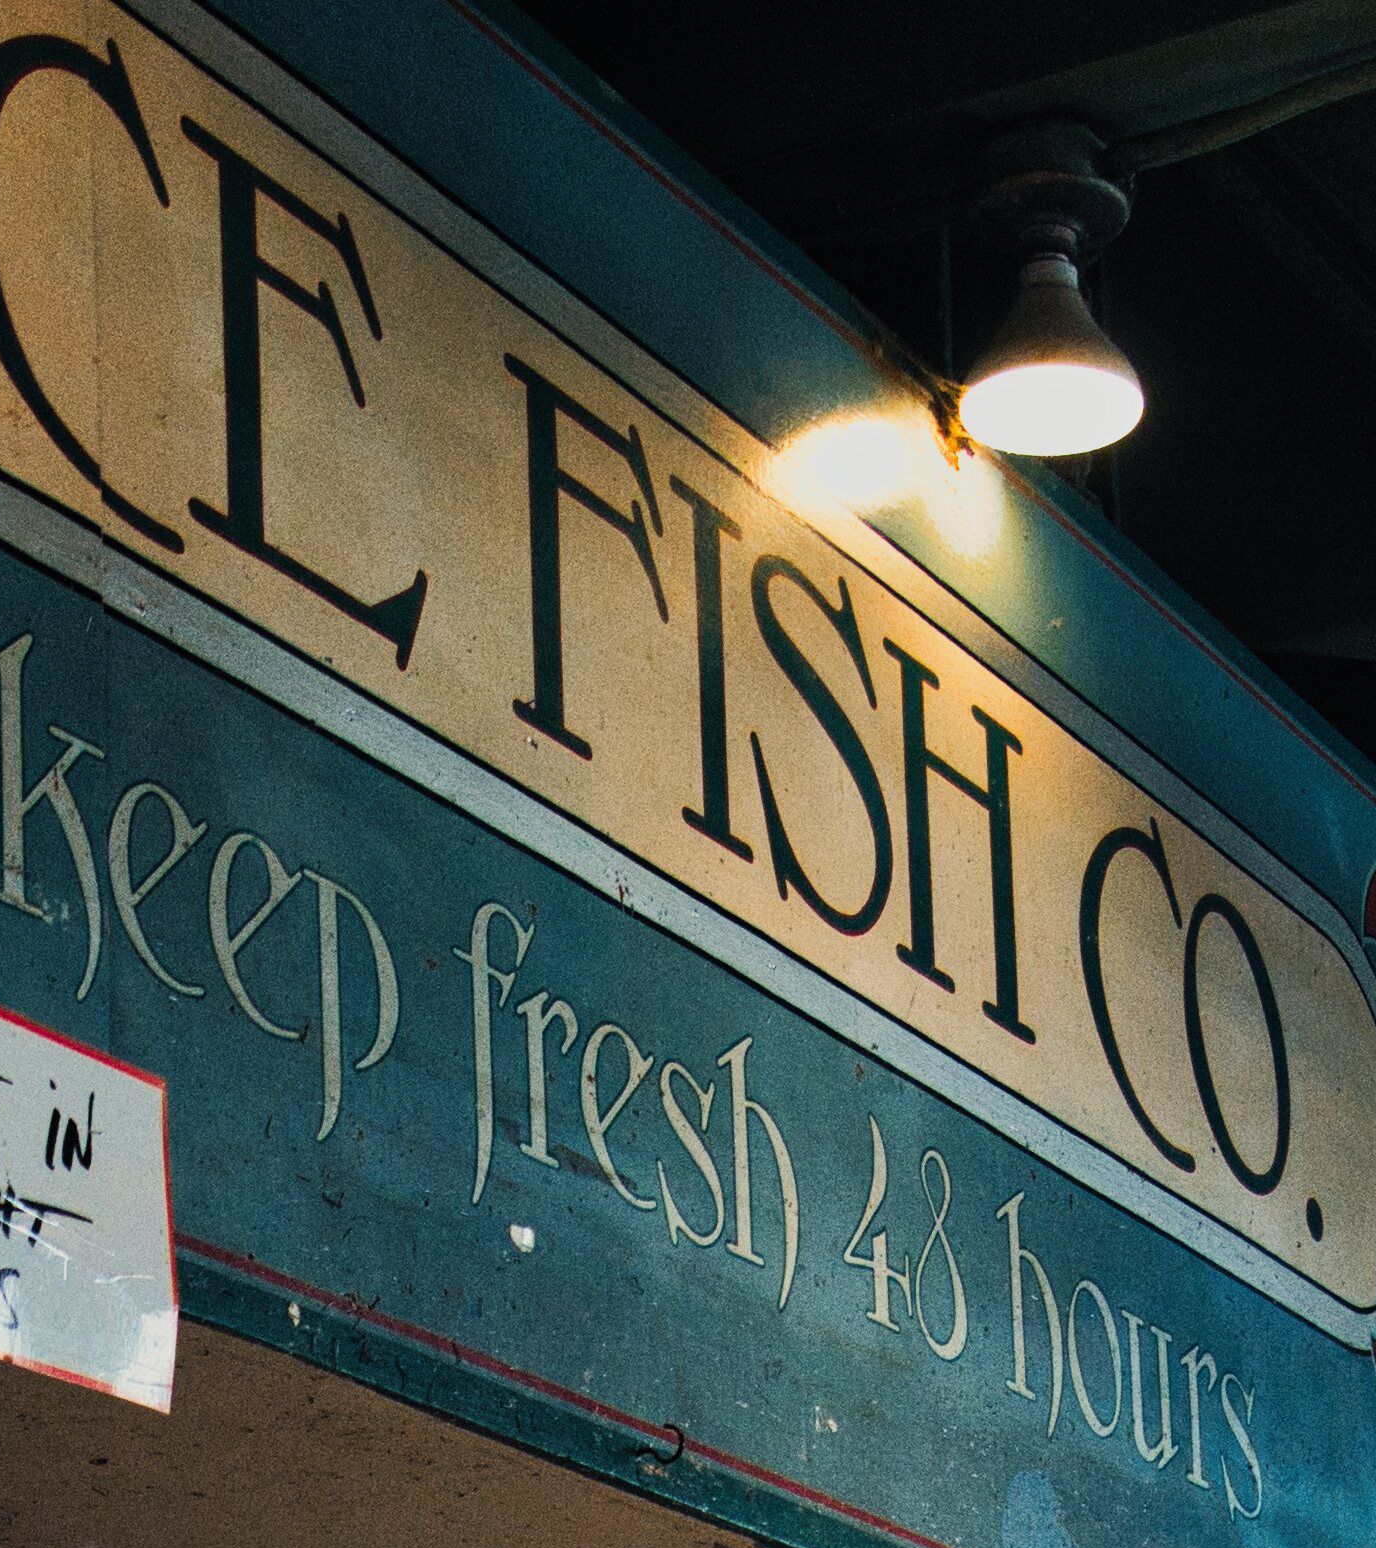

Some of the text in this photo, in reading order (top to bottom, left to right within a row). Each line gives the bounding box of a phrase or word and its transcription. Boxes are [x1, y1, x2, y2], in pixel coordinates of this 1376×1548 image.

[502, 352, 1040, 1045] FISH
[1076, 817, 1327, 1245] CO.
[451, 900, 801, 1313] fresh
[842, 1113, 969, 1366] 48
[994, 1188, 1264, 1520] hours
